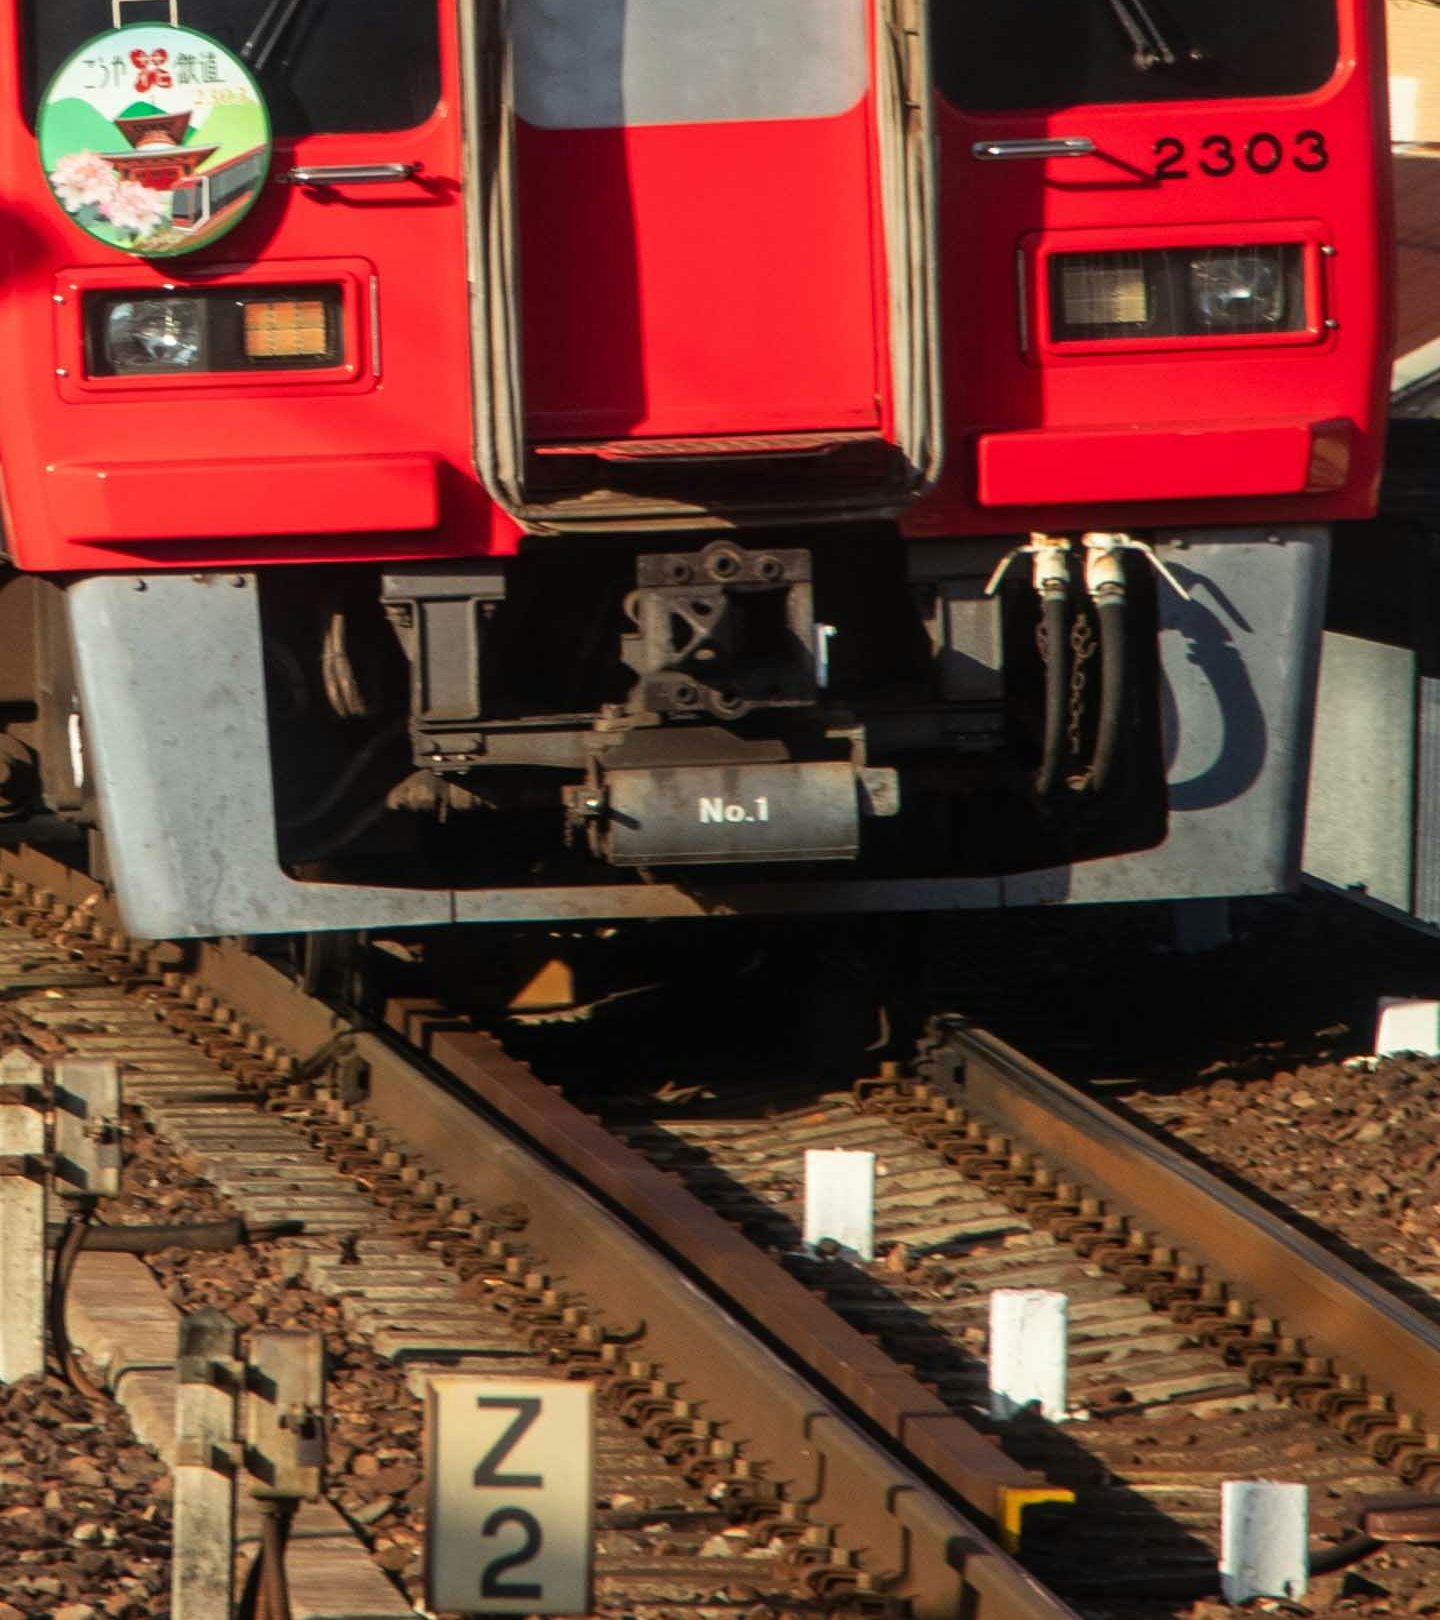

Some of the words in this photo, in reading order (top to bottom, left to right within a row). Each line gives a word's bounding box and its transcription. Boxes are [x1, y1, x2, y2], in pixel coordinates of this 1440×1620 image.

[1152, 129, 1329, 179] 2303
[698, 796, 770, 823] No.1
[473, 1397, 544, 1487] Z
[479, 1505, 543, 1598] 2
